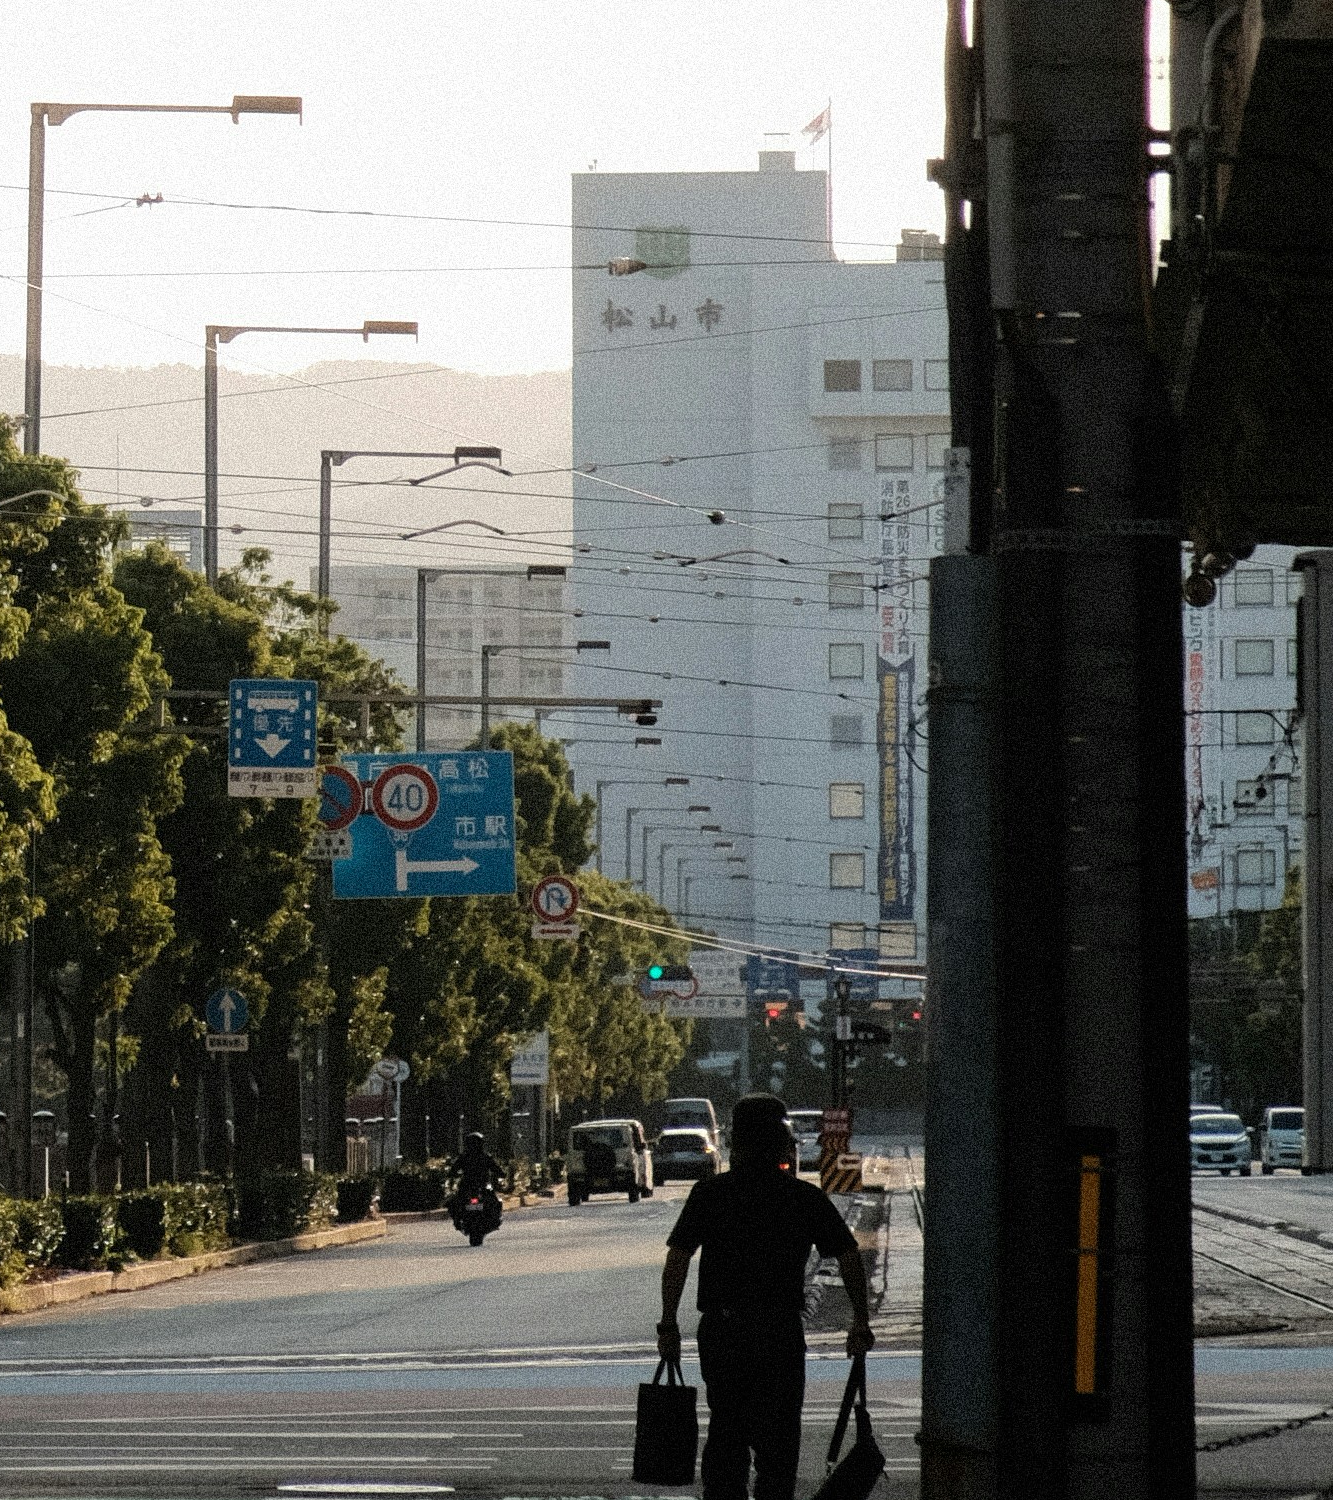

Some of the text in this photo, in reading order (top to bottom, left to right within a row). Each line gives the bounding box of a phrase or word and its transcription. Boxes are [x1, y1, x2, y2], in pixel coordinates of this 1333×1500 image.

[600, 298, 724, 333] 松山市
[438, 757, 489, 779] 高松
[387, 783, 423, 812] 40
[454, 815, 507, 836] 市駅
